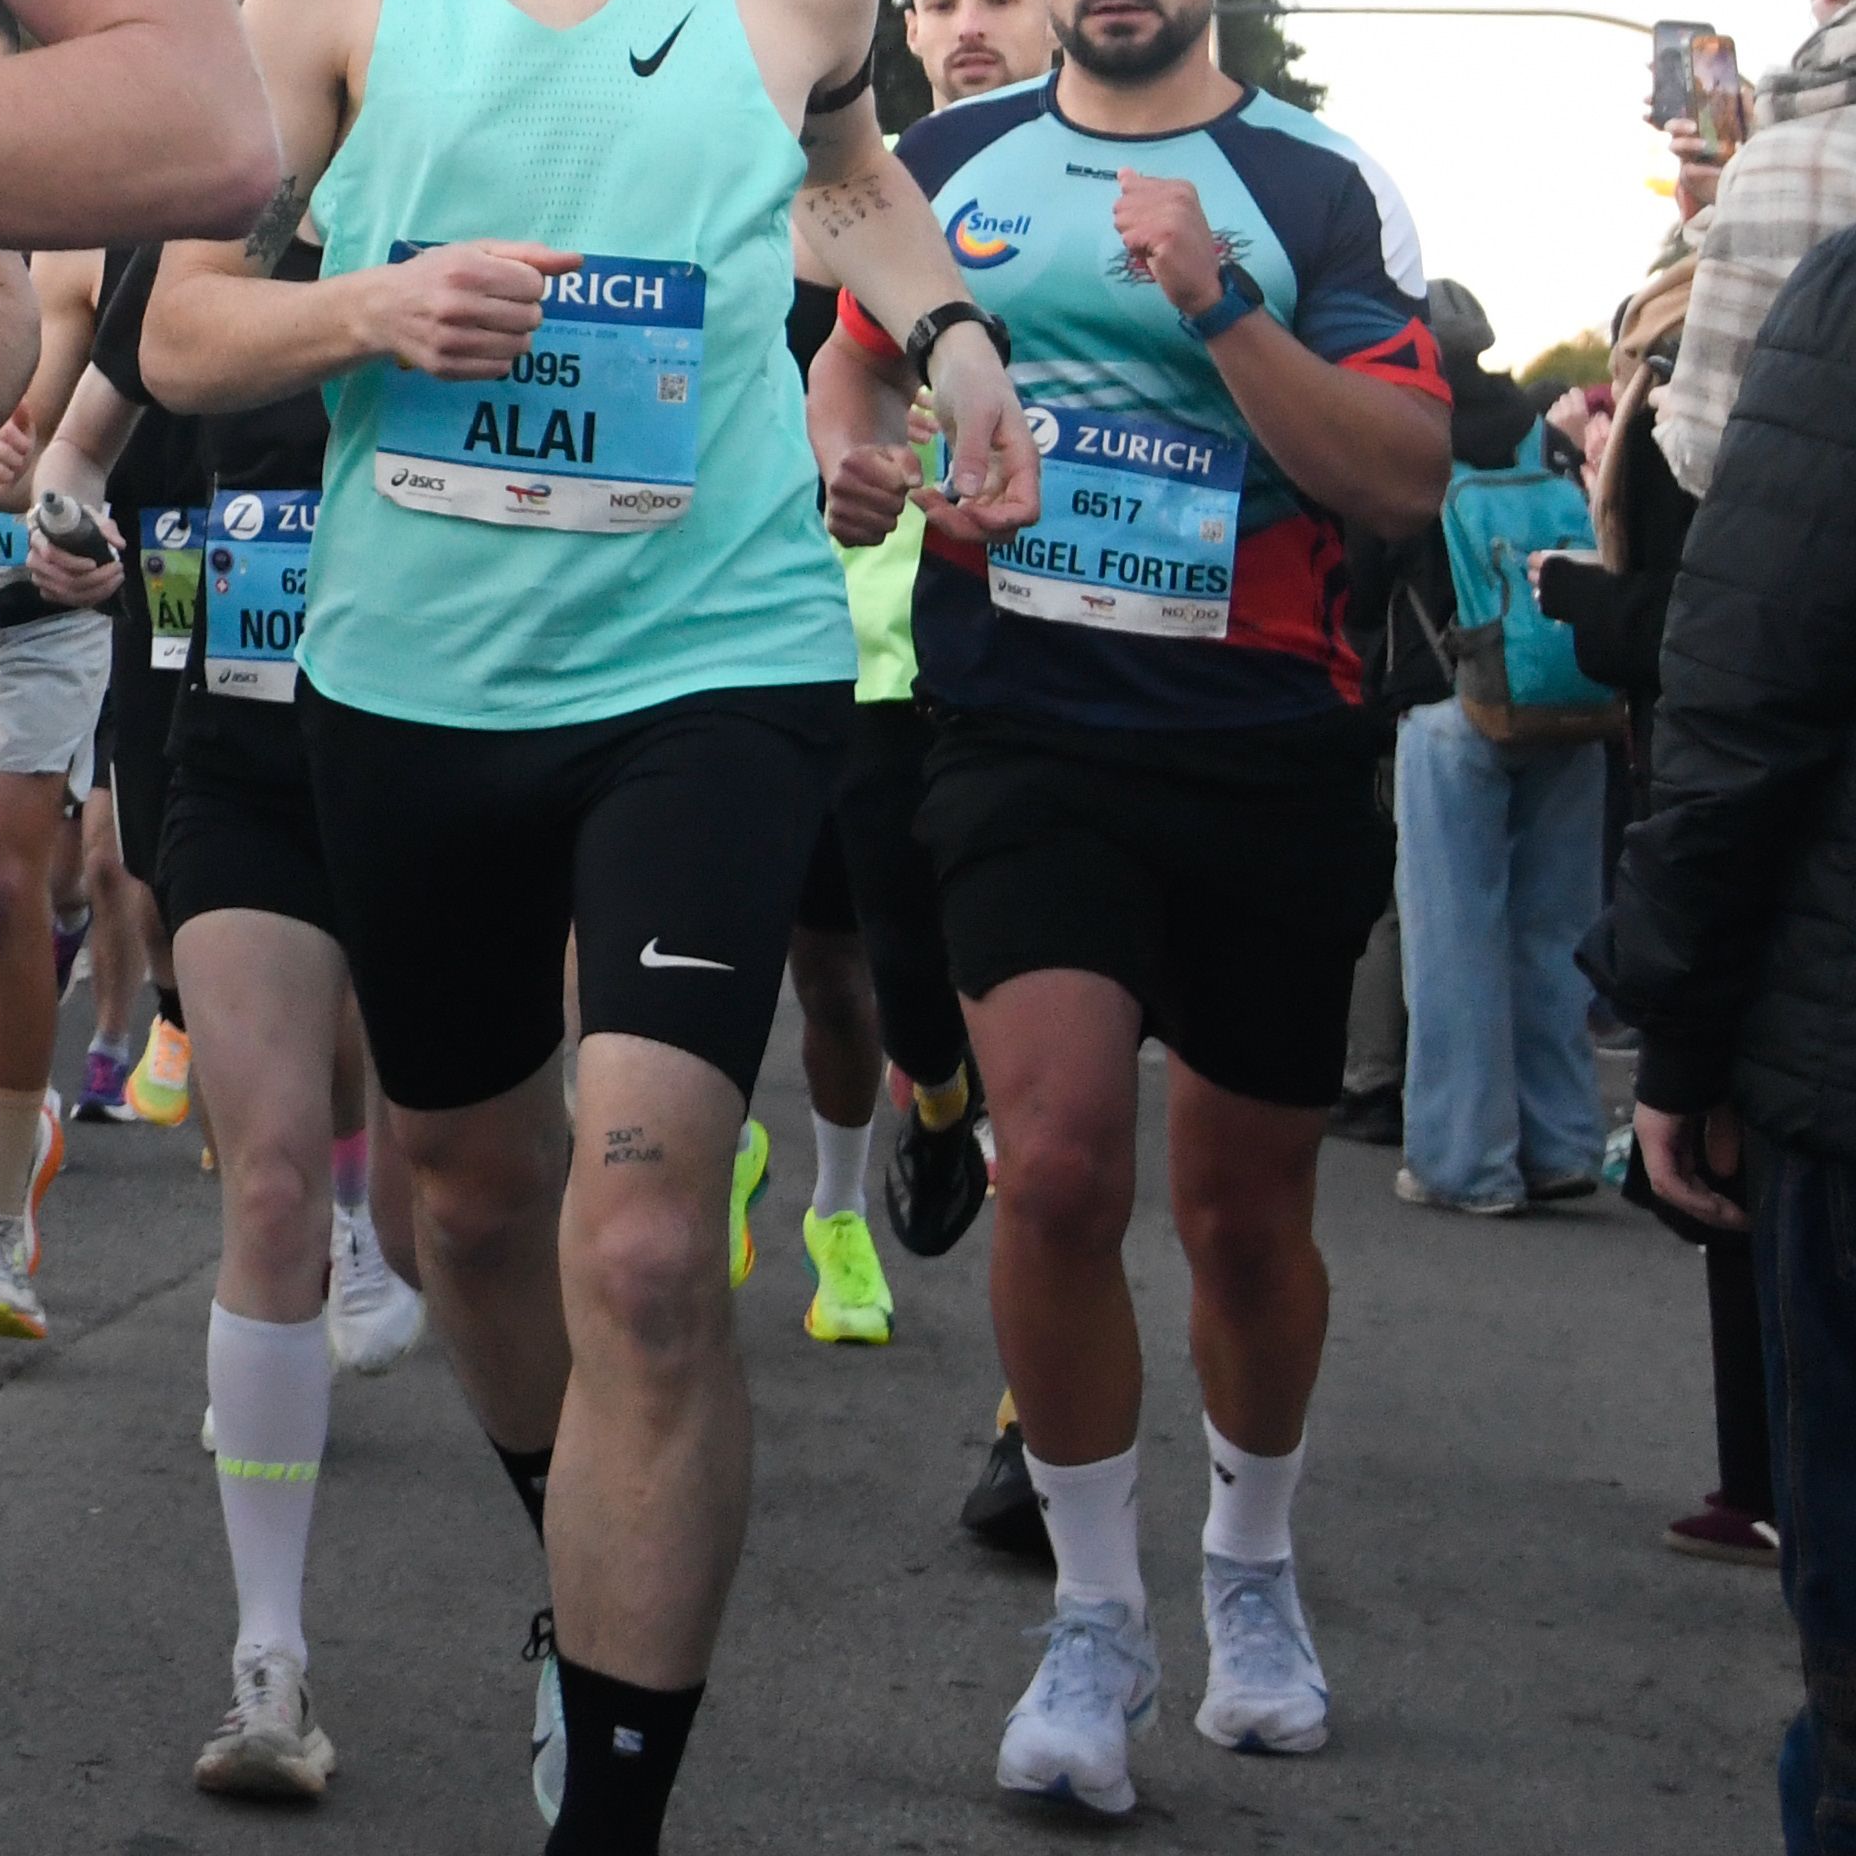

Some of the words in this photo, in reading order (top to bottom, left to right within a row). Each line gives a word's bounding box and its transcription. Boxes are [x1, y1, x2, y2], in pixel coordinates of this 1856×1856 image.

[970, 210, 1031, 236] Snell
[495, 352, 581, 388] 095
[463, 400, 597, 464] ALAI
[1075, 425, 1213, 475] ZURICH
[407, 473, 446, 492] asics
[1071, 488, 1144, 525] 6517
[1098, 548, 1229, 594] FORTES
